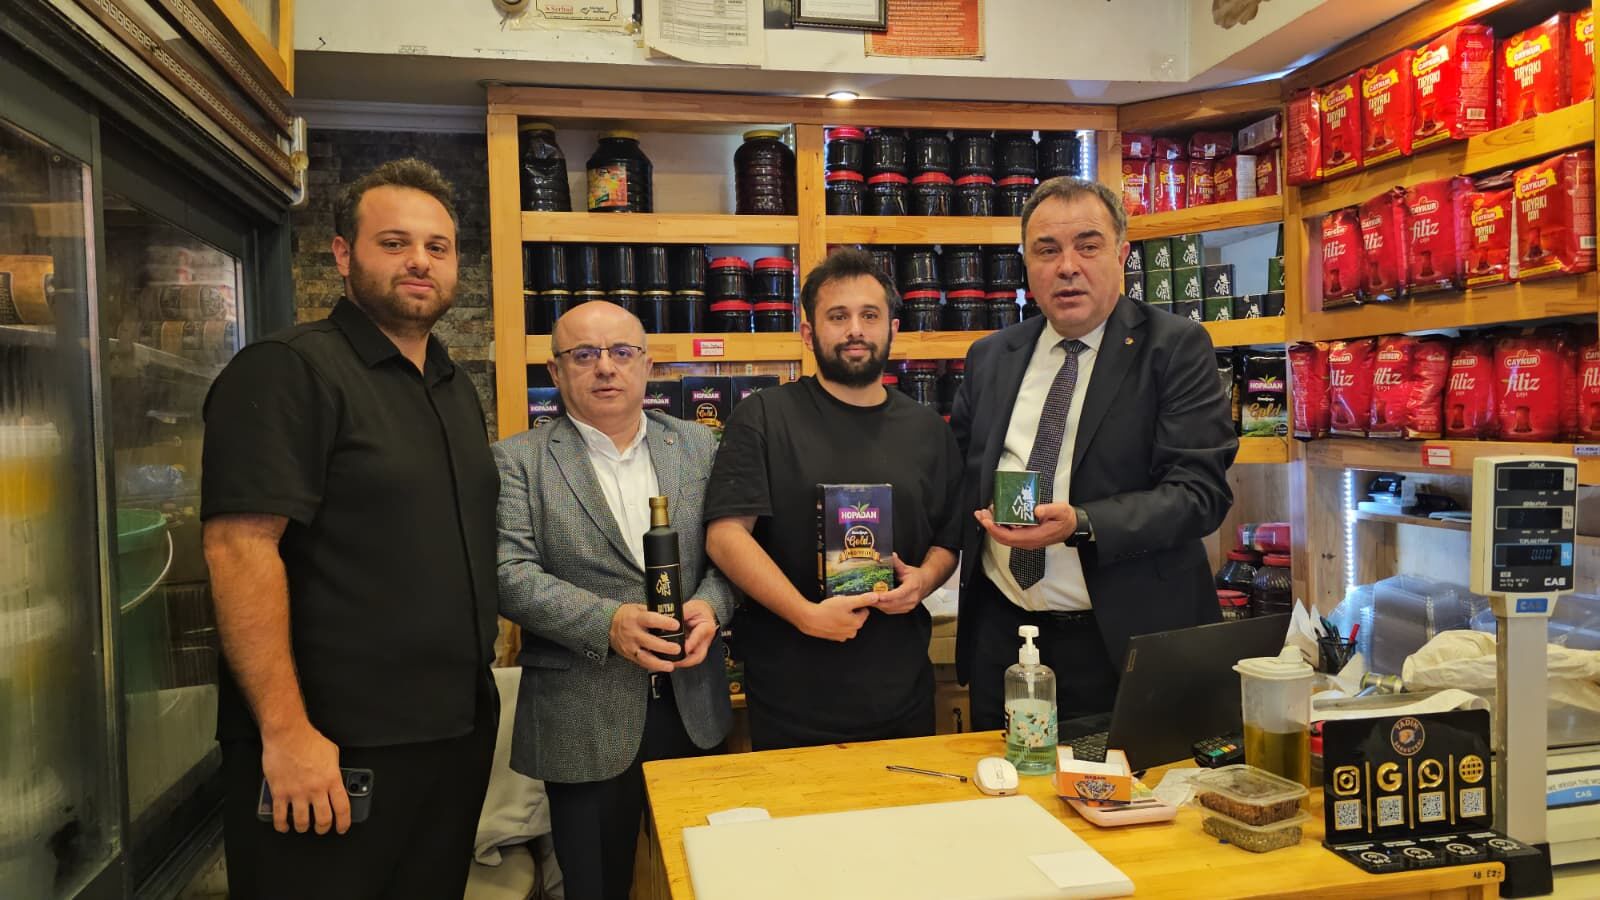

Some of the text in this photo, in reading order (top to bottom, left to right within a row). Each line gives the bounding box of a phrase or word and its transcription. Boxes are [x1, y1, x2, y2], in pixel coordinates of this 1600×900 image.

[1411, 219, 1440, 245] filiz
[1363, 232, 1384, 251] iliz
[1323, 240, 1346, 262] filiz
[1373, 367, 1402, 385] filiz
[1449, 372, 1475, 393] filiz
[1504, 372, 1541, 397] filiz
[1248, 403, 1282, 420] Gold
[841, 511, 877, 519] HOPADAN
[847, 535, 870, 547] Gold
[1544, 577, 1566, 586] CAS
